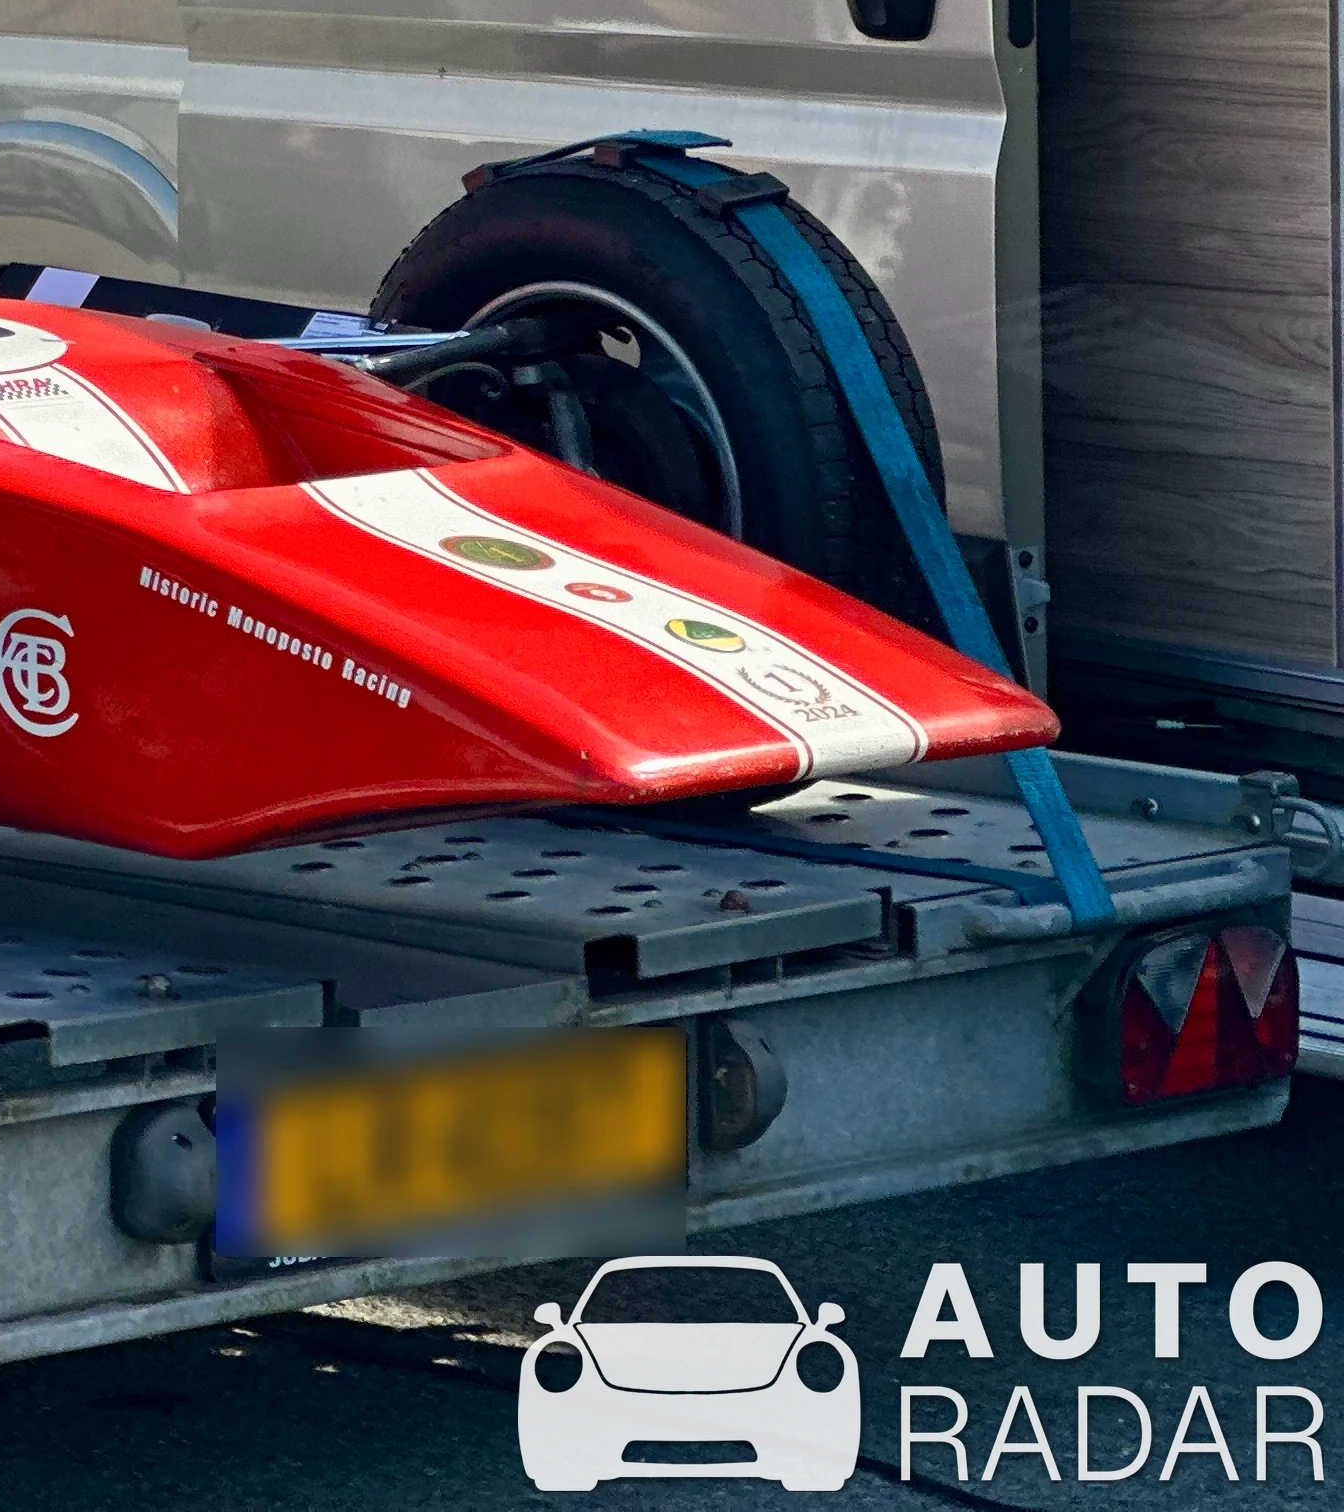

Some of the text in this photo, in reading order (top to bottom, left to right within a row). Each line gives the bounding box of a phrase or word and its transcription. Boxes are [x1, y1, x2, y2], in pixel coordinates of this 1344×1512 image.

[140, 566, 412, 709] Historic Monoposto Racing
[793, 704, 861, 723] 2024
